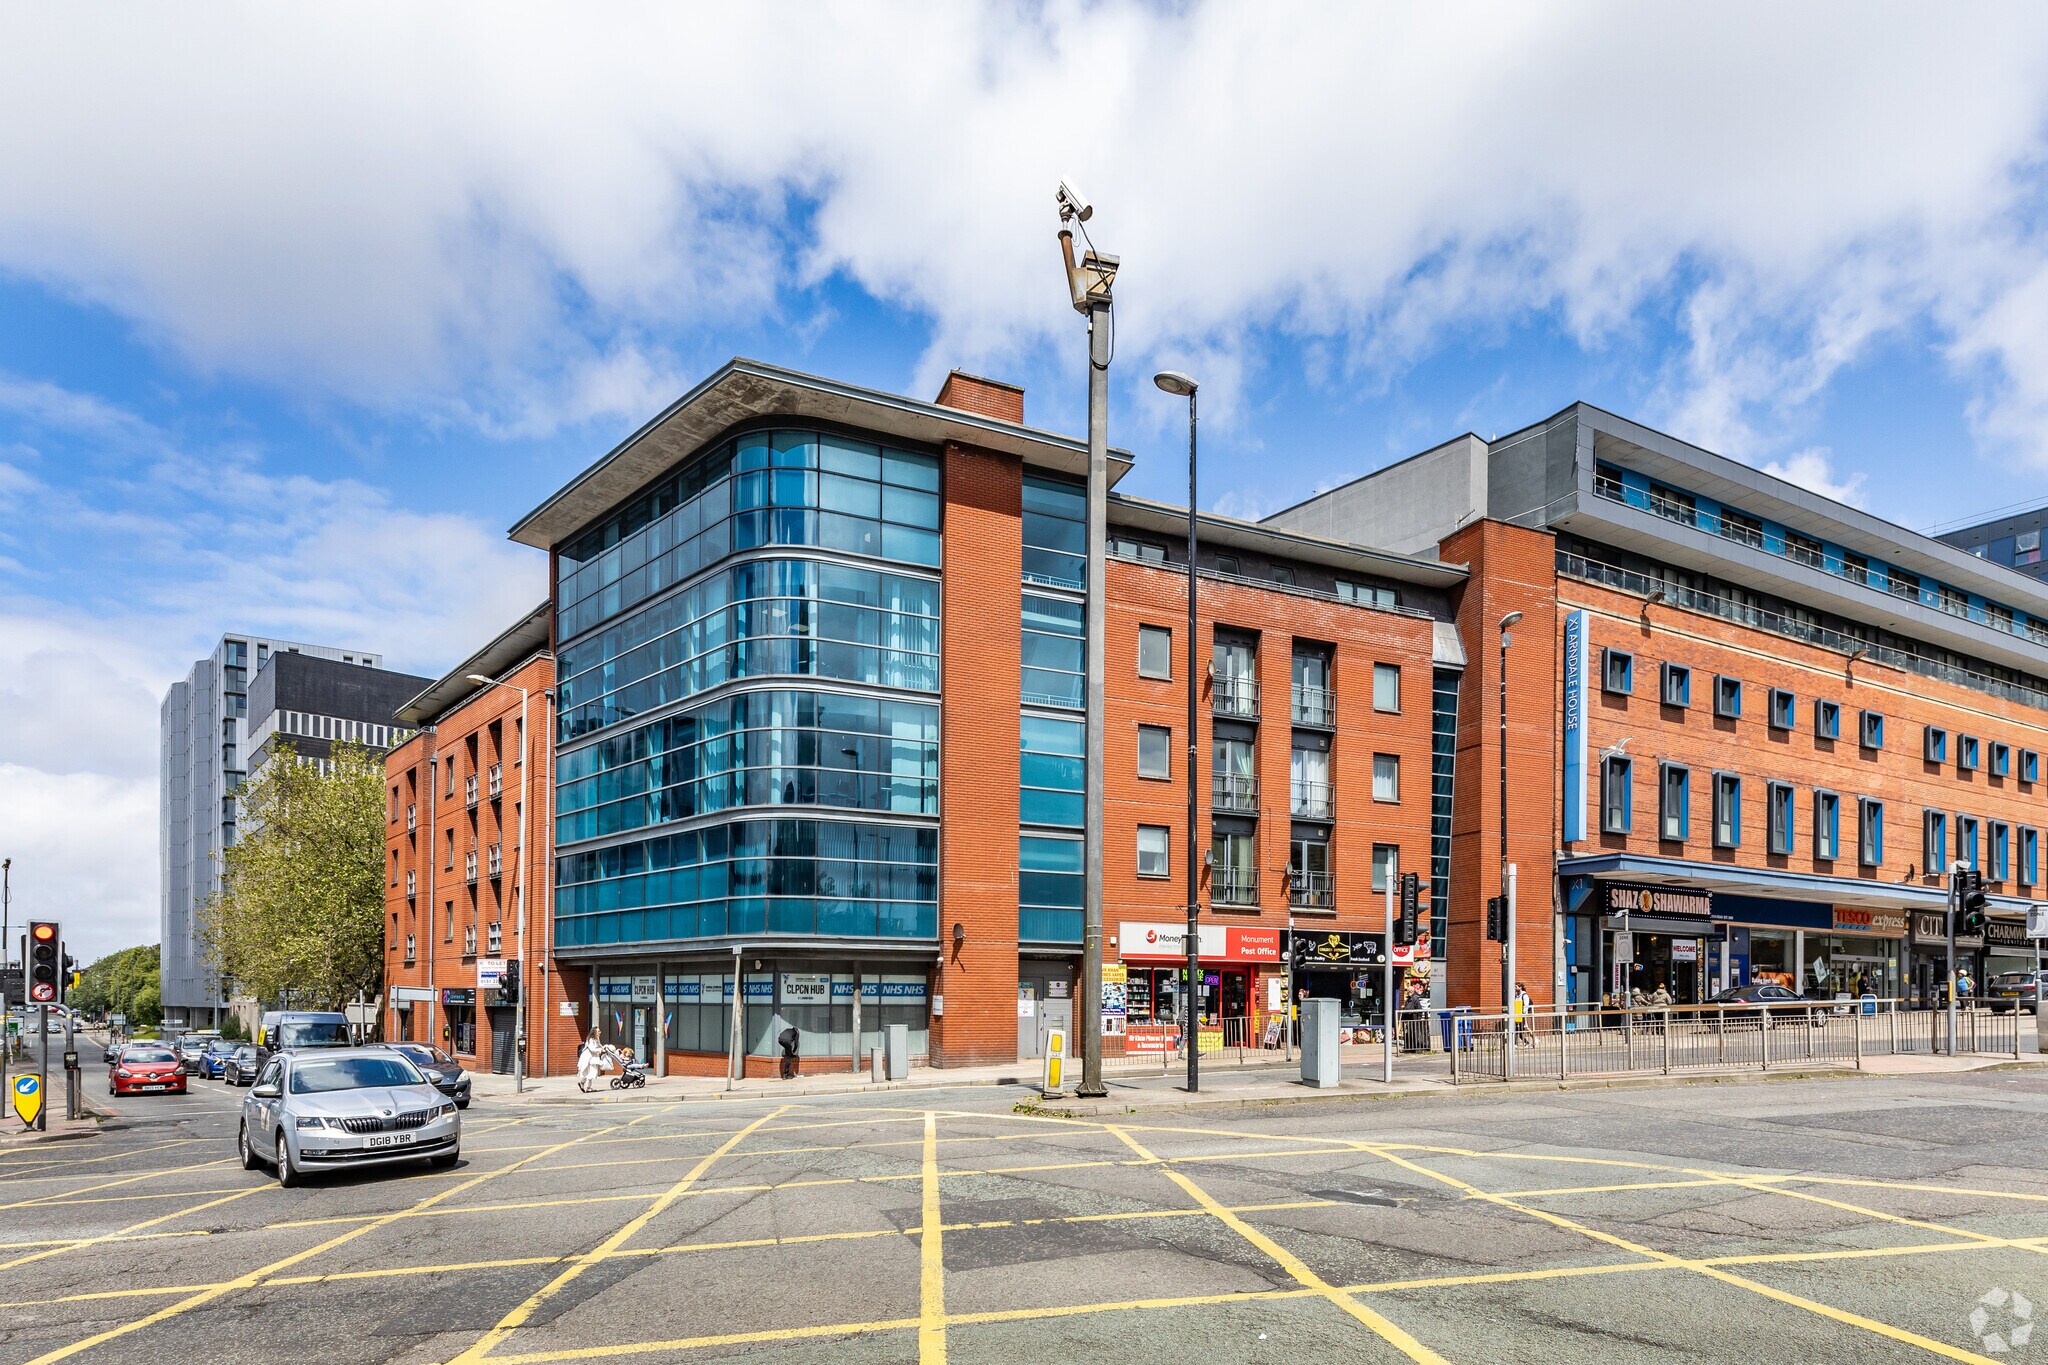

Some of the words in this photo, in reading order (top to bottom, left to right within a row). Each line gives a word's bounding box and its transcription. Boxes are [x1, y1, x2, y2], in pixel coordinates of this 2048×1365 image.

[1568, 616, 1578, 632] X1
[1568, 634, 1578, 688] ARNDALE
[1567, 690, 1578, 730] HOUSE
[1571, 878, 1584, 890] X1
[1611, 888, 1639, 910] SHAZ
[1653, 892, 1710, 916] SHAWARMA
[1834, 908, 1872, 924] TESCO
[1872, 914, 1905, 930] express
[1242, 935, 1274, 944] Monument
[1242, 946, 1256, 955] Post
[1257, 948, 1276, 956] Office
[786, 984, 809, 994] CLPCN
[810, 984, 825, 994] HUB
[834, 984, 854, 994] NHS
[882, 985, 904, 994] NHS
[904, 985, 924, 994] NHS
[370, 1136, 390, 1146] DG18
[393, 1134, 411, 1143] YBR
